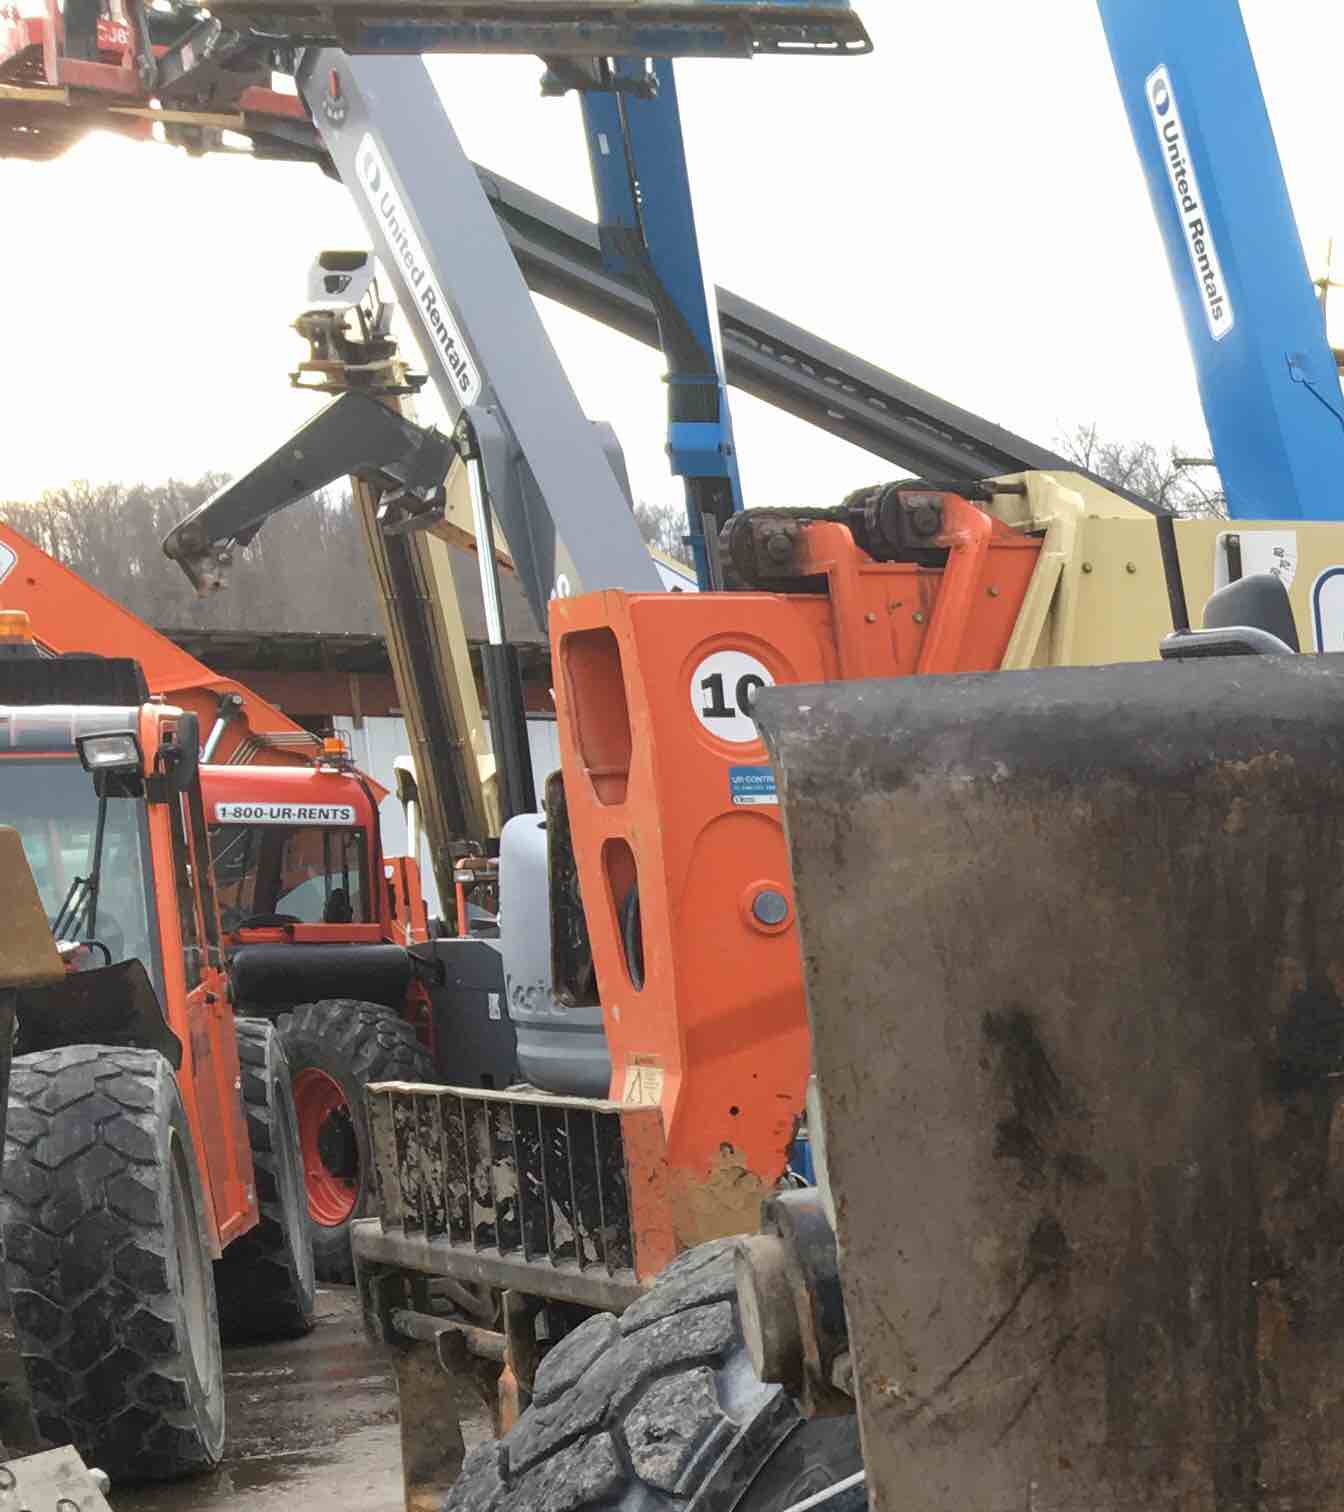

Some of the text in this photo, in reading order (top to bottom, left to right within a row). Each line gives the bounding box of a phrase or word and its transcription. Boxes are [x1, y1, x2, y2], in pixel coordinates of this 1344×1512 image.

[378, 192, 471, 393] United Rentals
[1163, 120, 1225, 321] United Rentals
[221, 807, 351, 820] 1-800-UR-RENTS
